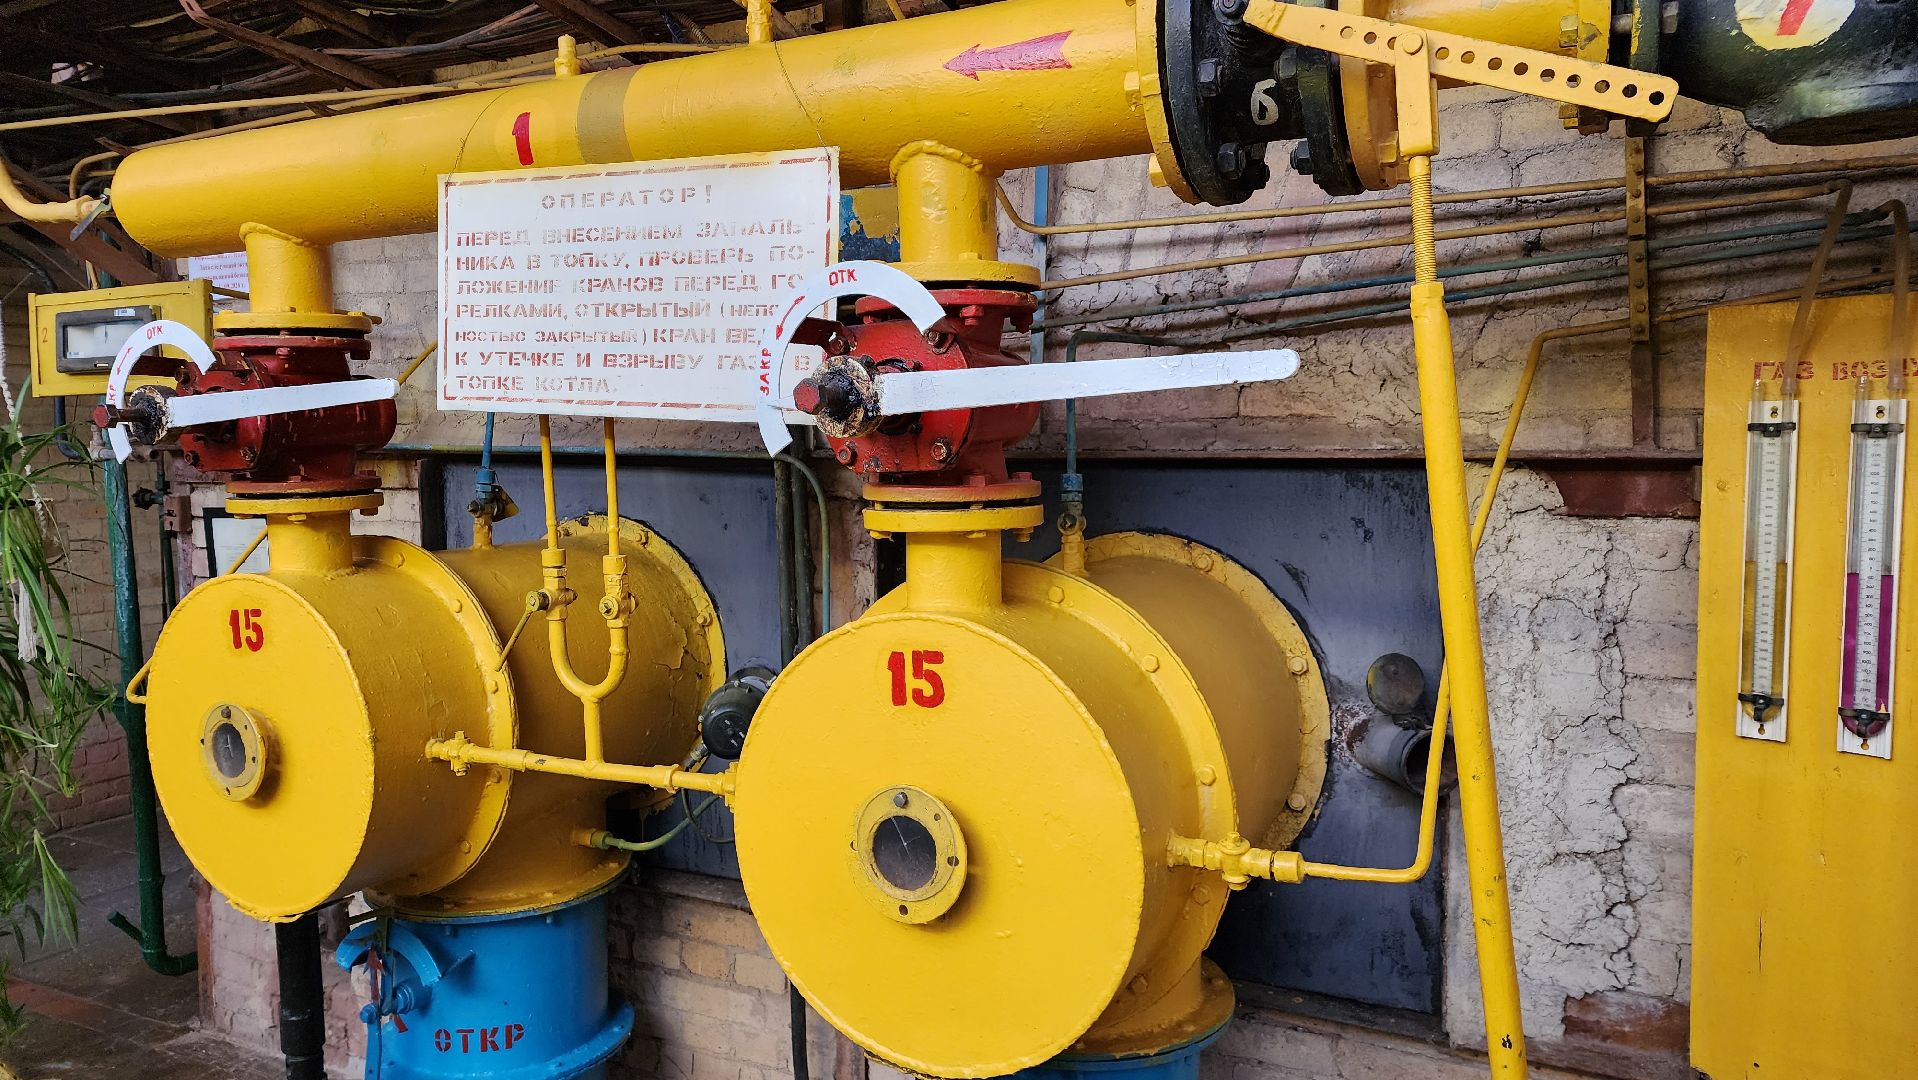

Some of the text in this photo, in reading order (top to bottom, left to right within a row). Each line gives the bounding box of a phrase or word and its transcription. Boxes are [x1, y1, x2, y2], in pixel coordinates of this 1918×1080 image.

[512, 111, 534, 167] 1
[541, 184, 712, 210] ОПЕРАТОР!
[456, 229, 531, 247] ПЕРЕД
[542, 224, 683, 244] ВНЕСЕНИЕМ
[456, 255, 516, 271] НИКА
[526, 254, 541, 270] В
[639, 247, 754, 267] ПРОВЕРЬ
[456, 279, 561, 295] ЛОЖЕНИЕ
[572, 276, 664, 294] КРАНОВ
[674, 274, 760, 293] ПЕРЕД
[828, 268, 858, 288] ОТК
[456, 303, 568, 321] РЕЛКАМИ,
[575, 299, 711, 318] ОТКРЫТЫЙ
[41, 327, 48, 343] 2
[146, 325, 163, 340] ОТК
[455, 327, 765, 346] НОСТЬЮ ЗАКРЫТЫЙ) КРАН ВЕ
[455, 351, 468, 366] К
[479, 351, 565, 367] УТЕЧКЕ
[576, 352, 591, 368] И
[603, 353, 704, 369] ВЗРЫВУ
[759, 347, 772, 396] ЗАКР
[455, 375, 525, 391] ТОПКЕ
[229, 608, 264, 652] 15
[887, 650, 945, 708] 15
[434, 1023, 525, 1054] ОТКР
